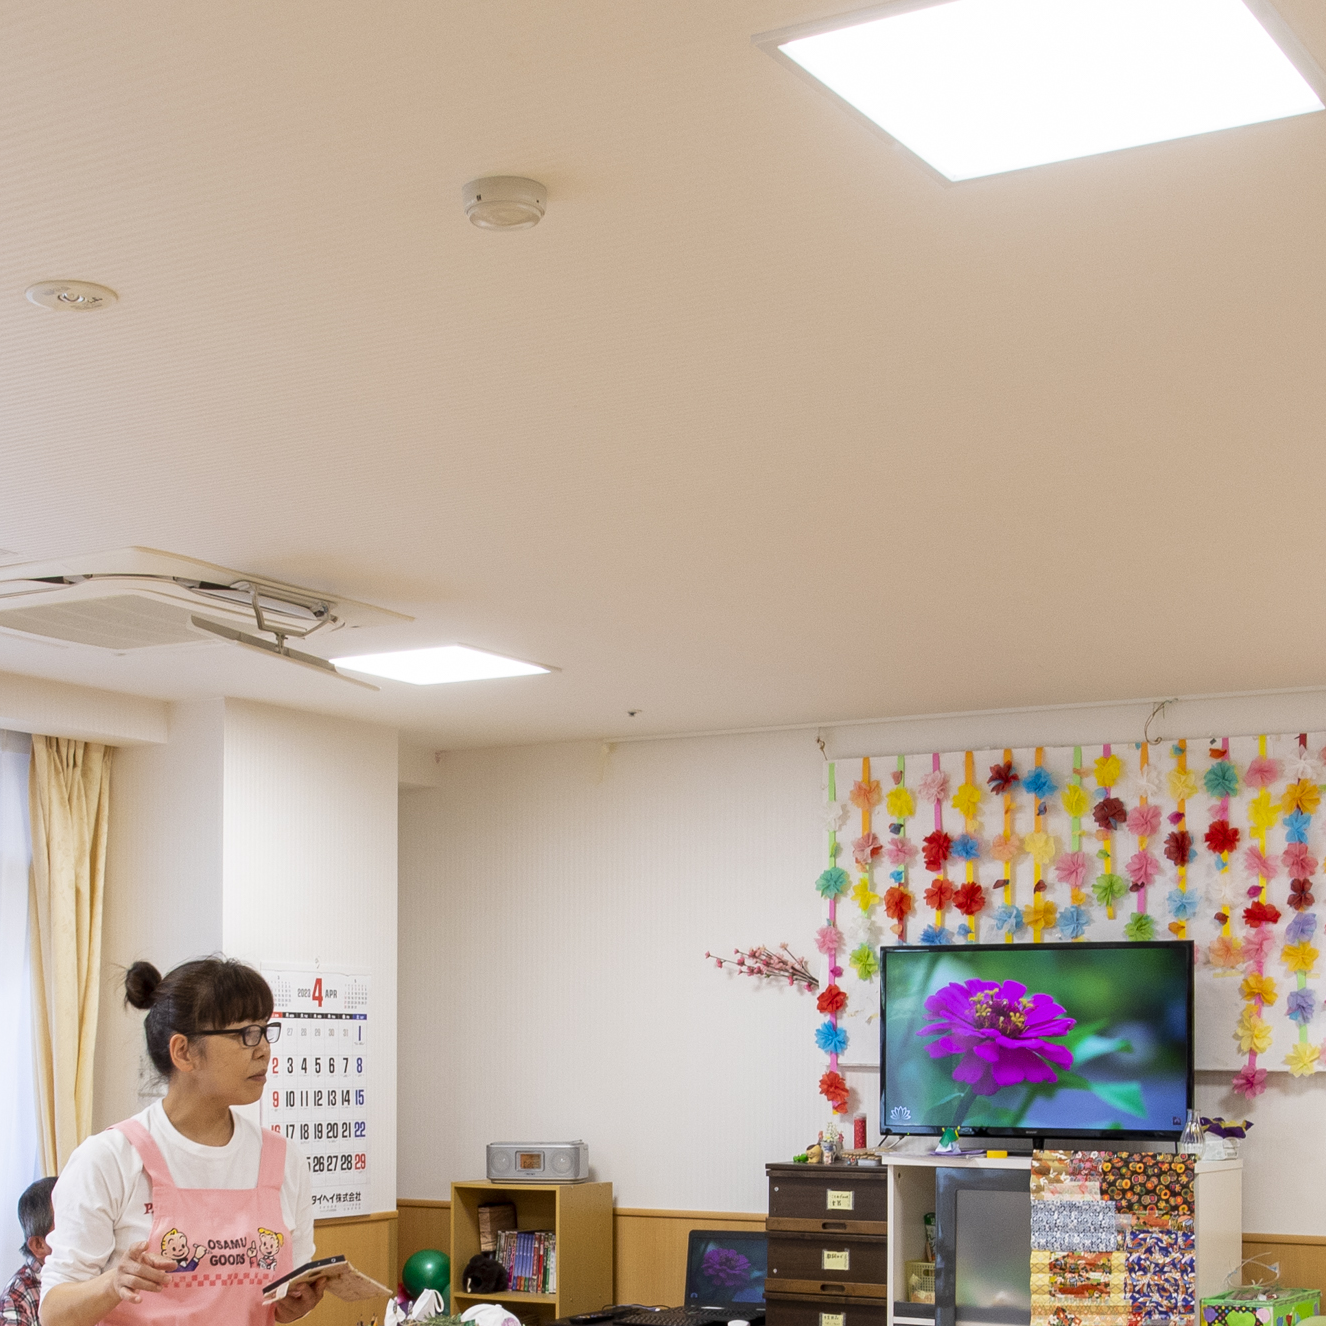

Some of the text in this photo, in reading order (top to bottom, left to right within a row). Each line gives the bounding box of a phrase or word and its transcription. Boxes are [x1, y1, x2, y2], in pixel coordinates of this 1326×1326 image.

[298, 978, 337, 1007] 2023 4 APR
[272, 1057, 362, 1073] 2 3 4 5 6 7 8
[273, 1090, 364, 1107] 9 10 11 12 13 14 15
[286, 1124, 295, 1139] 17
[300, 1124, 309, 1140] 18
[314, 1123, 323, 1139] 19
[327, 1123, 338, 1138] 20
[342, 1122, 351, 1138] 21
[355, 1122, 365, 1137] 22
[313, 1156, 324, 1172] 26
[327, 1156, 338, 1171] 27
[341, 1154, 352, 1170] 28
[355, 1154, 366, 1169] 29
[207, 1236, 247, 1251] OSAMU
[209, 1253, 246, 1266] GOODS
